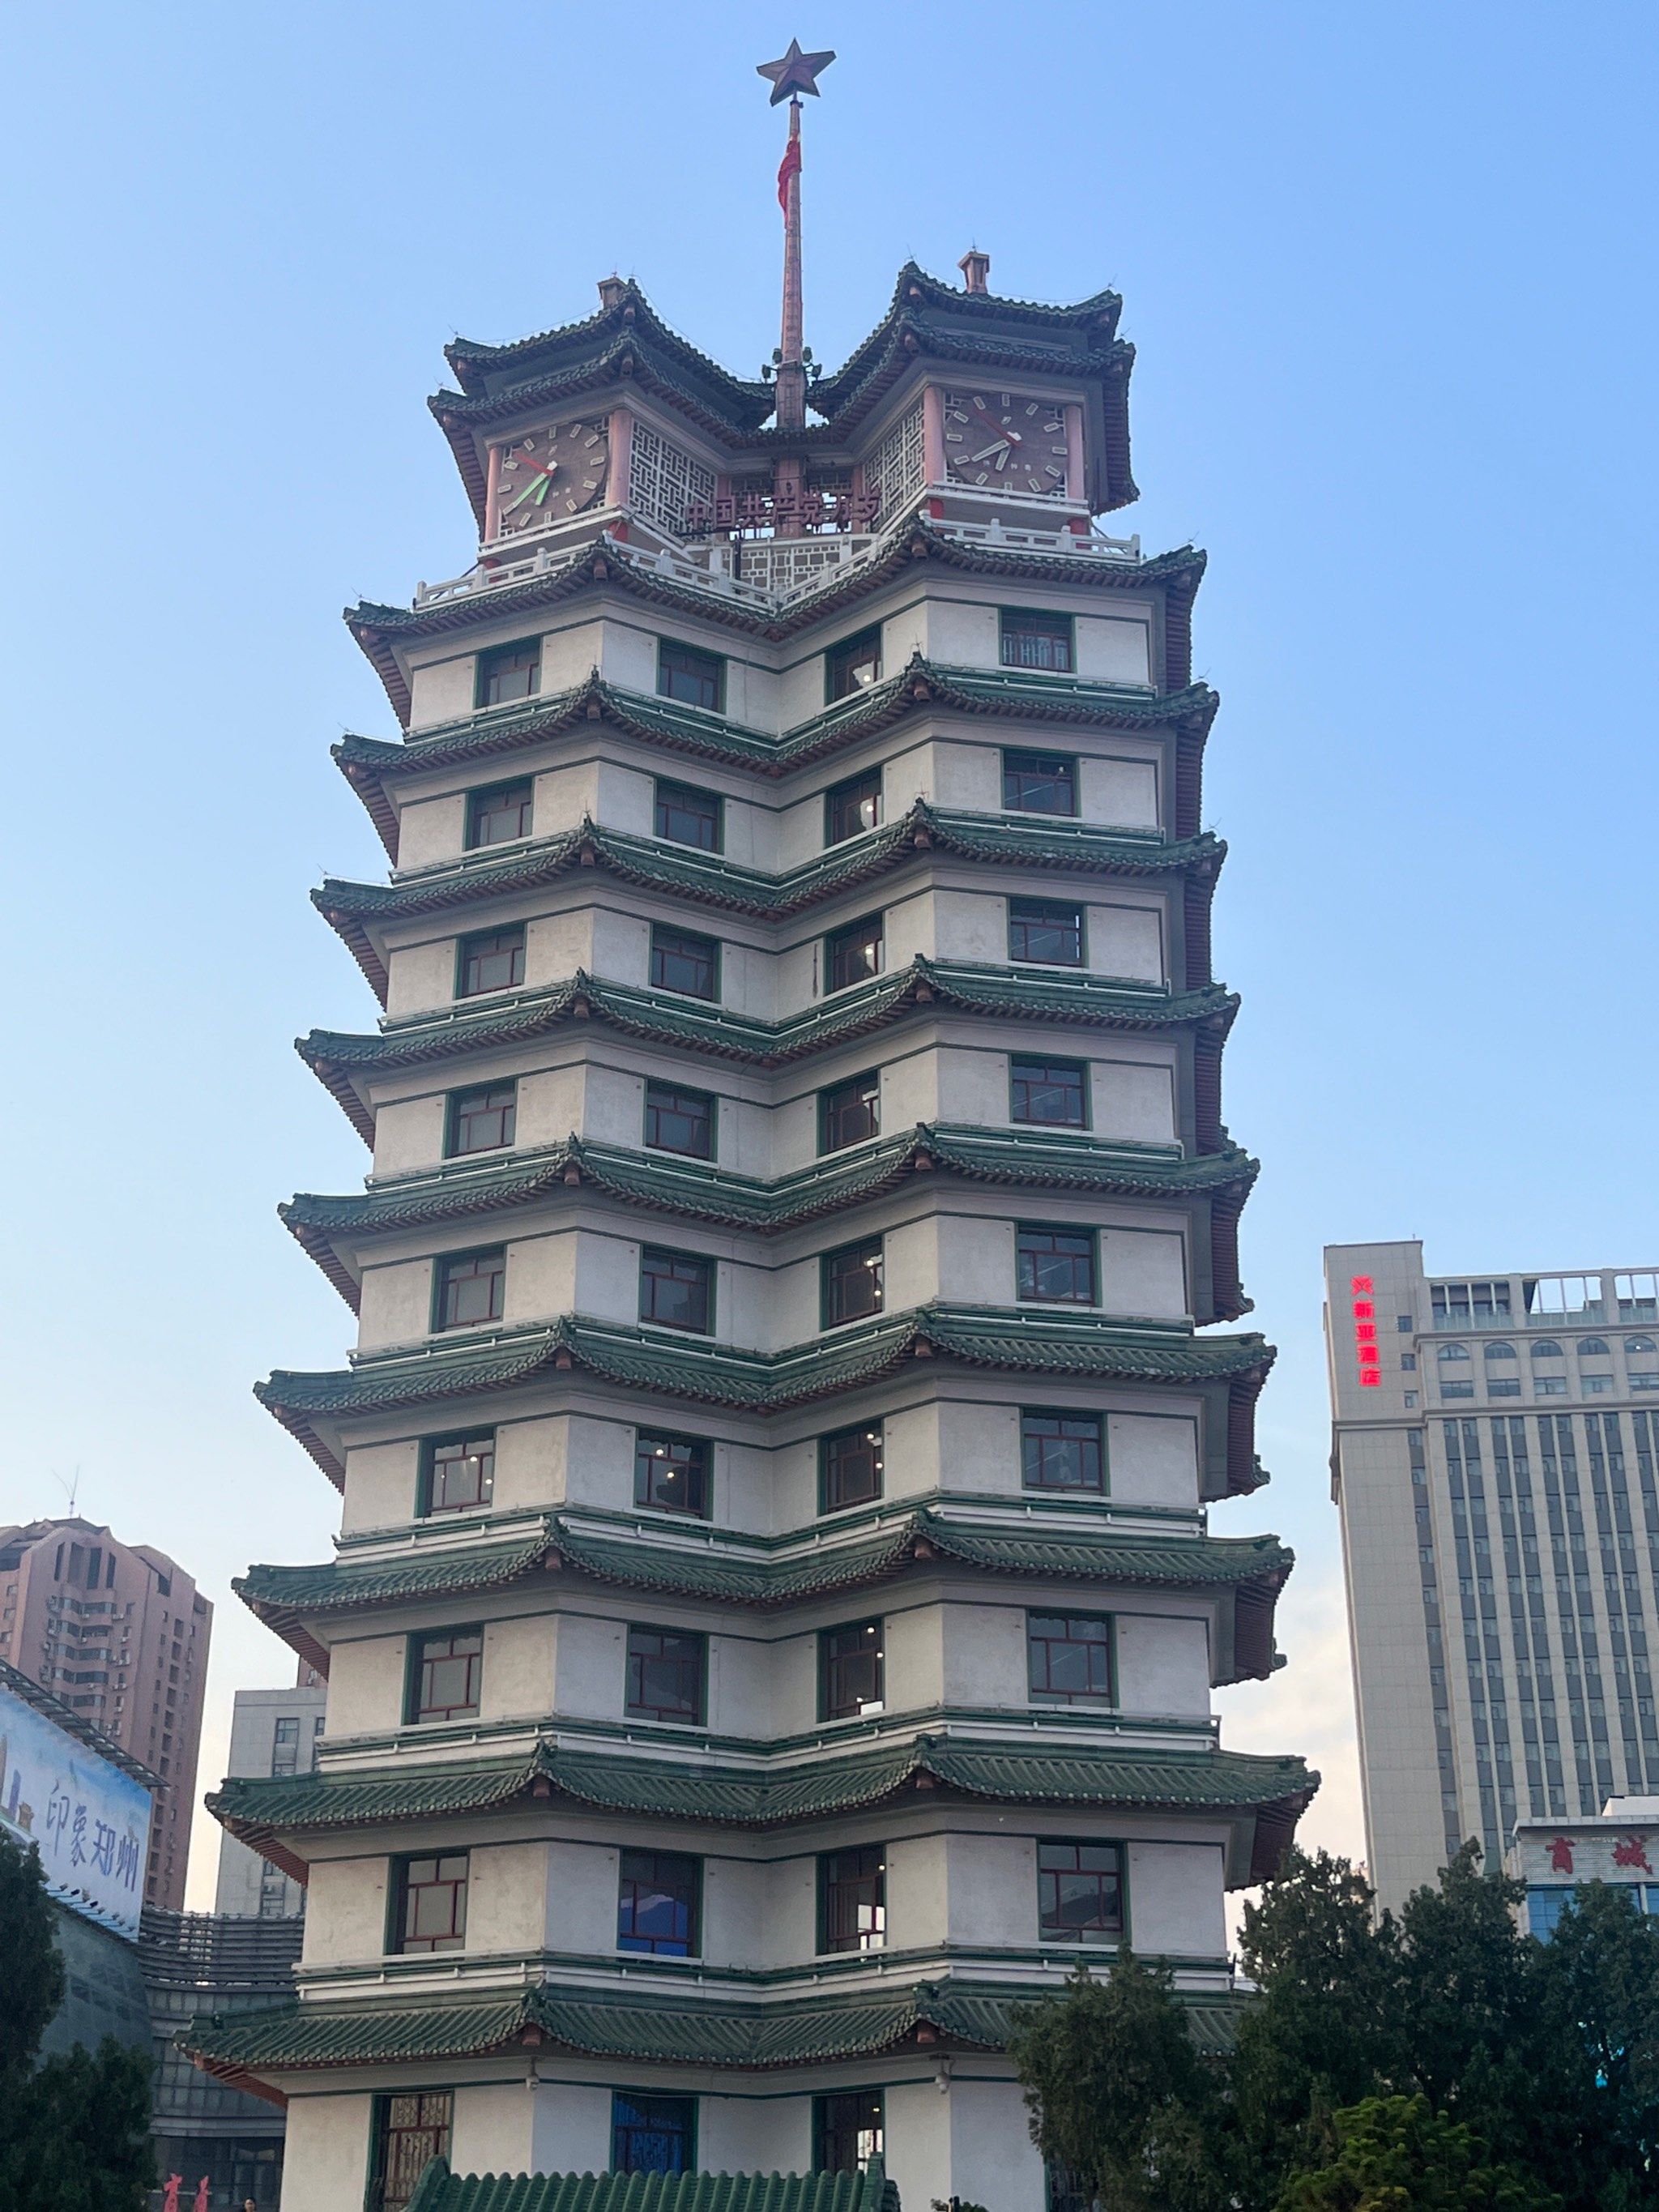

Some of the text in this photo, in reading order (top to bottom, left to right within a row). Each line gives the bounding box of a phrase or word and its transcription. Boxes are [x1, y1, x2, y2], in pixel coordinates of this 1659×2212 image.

[685, 486, 881, 531] 中国共产党万岁
[1352, 1299, 1381, 1386] 新亚酒店
[46, 1779, 139, 1892] 印象郑州
